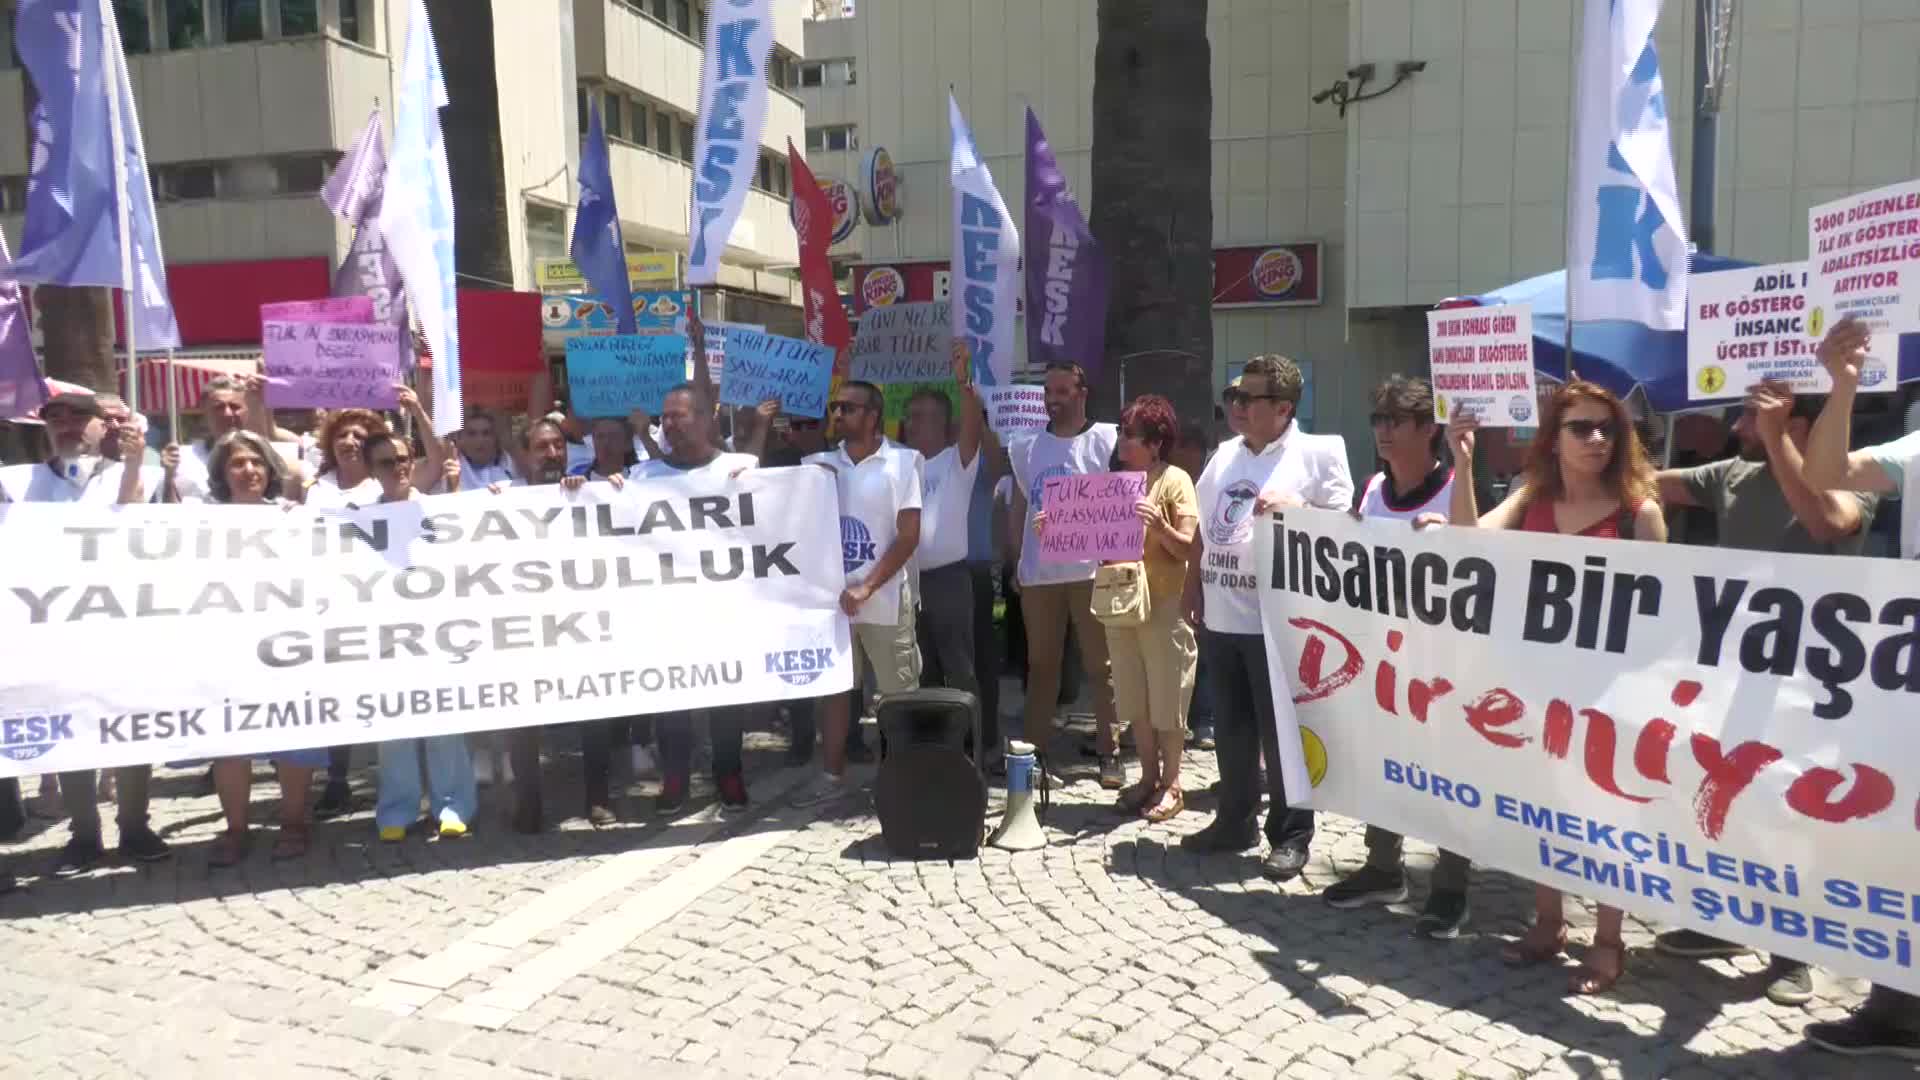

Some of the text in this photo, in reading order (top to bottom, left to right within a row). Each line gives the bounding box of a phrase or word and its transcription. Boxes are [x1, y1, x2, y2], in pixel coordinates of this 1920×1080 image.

[1814, 211, 1845, 234] 3600
[1753, 269, 1796, 292] ADİL
[865, 282, 900, 306] KING
[1700, 303, 1720, 320] EK
[1735, 317, 1805, 337] İNSANC
[1717, 341, 1768, 362] ÜCRET
[421, 491, 755, 544] SAYILARI
[1096, 532, 1120, 553] VAR
[1200, 568, 1257, 590] ABİP ODAS
[256, 610, 613, 668] GERÇEK!
[764, 647, 836, 674] KESK
[100, 660, 744, 744] KESK İZMİR ŞUBELER PLATFORMU
[1287, 617, 1920, 841] Direniyo
[1383, 756, 1481, 809] BÜRO
[1494, 794, 1800, 896] EMEKÇİLERİ
[1538, 838, 1912, 969] İZMİR ŞUBESİ
